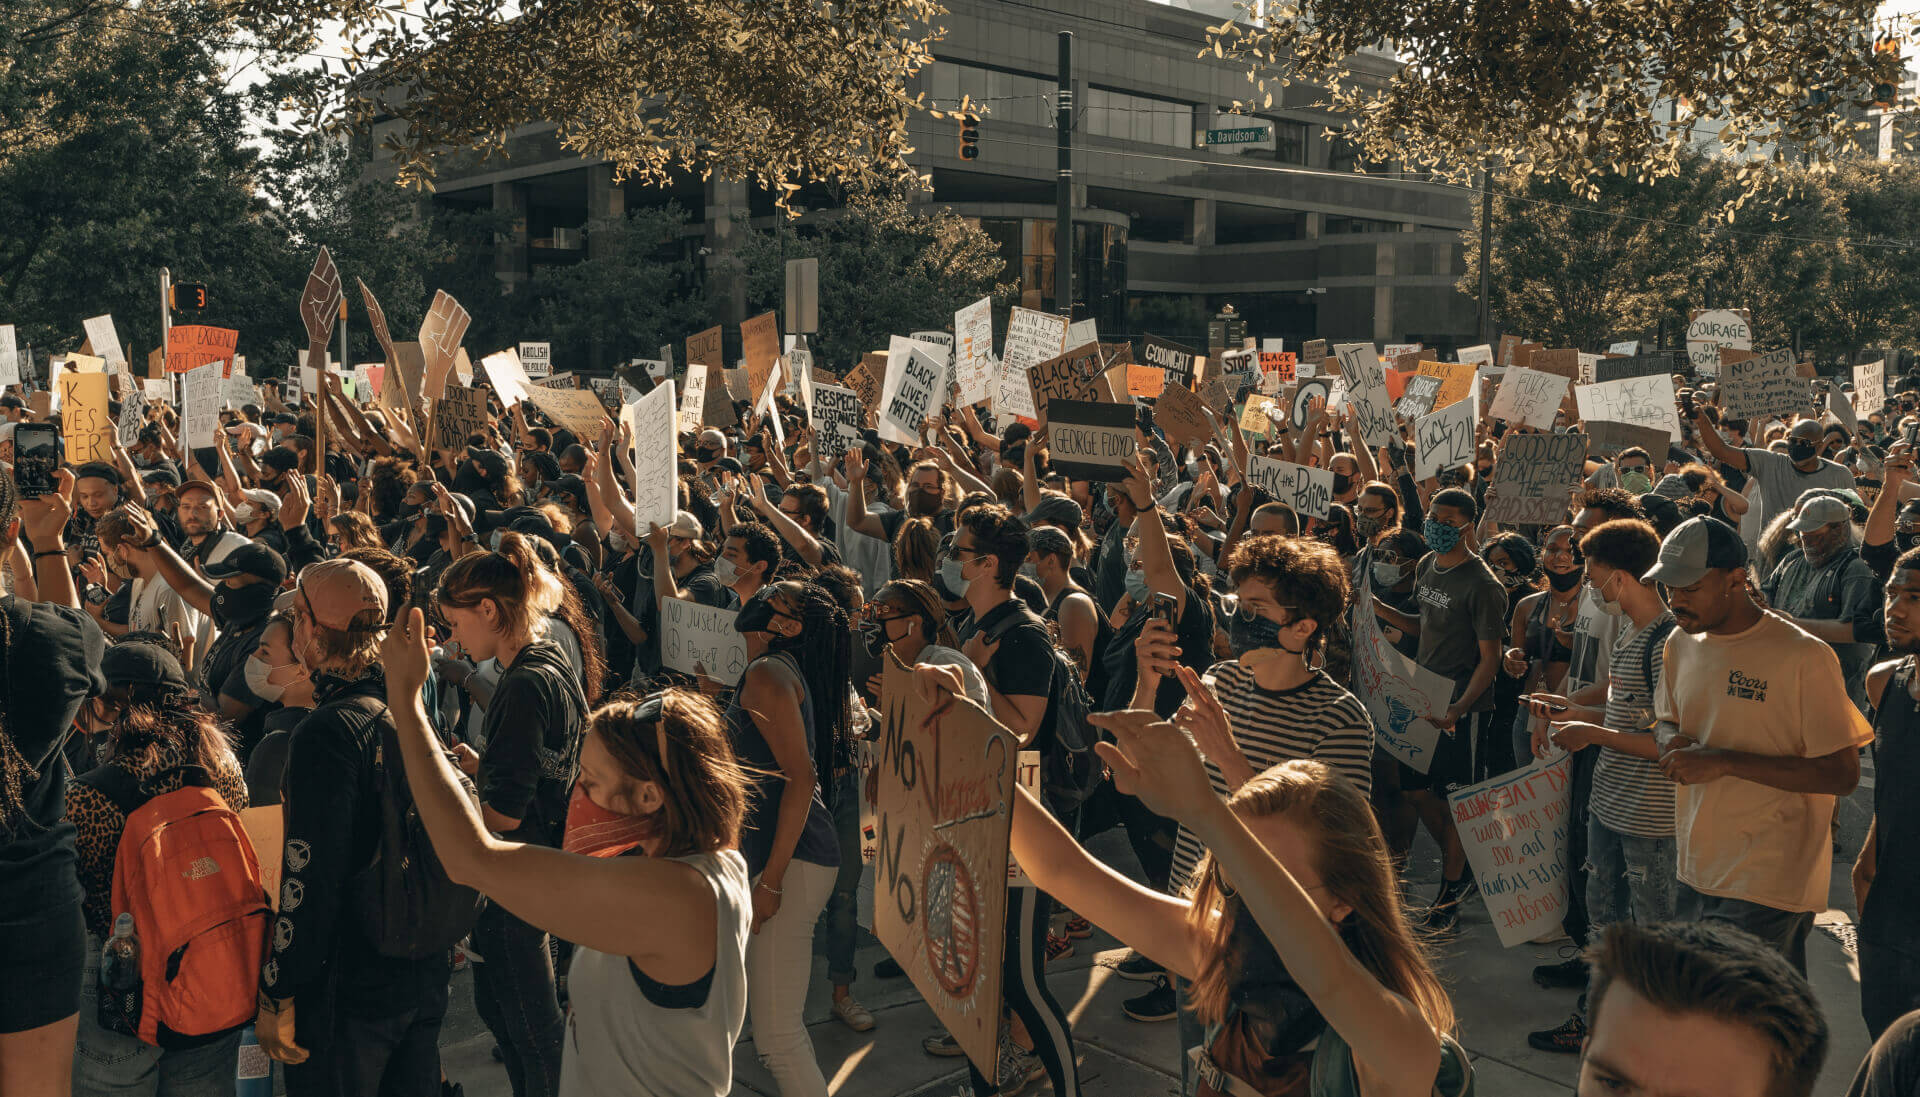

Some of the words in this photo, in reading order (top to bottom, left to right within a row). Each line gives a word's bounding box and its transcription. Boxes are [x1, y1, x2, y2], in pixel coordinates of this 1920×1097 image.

[1217, 130, 1256, 143] Davidson
[196, 287, 206, 308] 3
[1689, 321, 1747, 339] COURAGE
[522, 346, 548, 359] ABOLISH
[1259, 352, 1292, 362] BLACK
[1385, 347, 1398, 357] IF
[522, 362, 531, 371] THE
[531, 362, 548, 372] POLICE
[905, 356, 937, 393] BLACK
[1030, 356, 1079, 390] BLACK
[1223, 353, 1252, 375] STOP
[1260, 363, 1291, 372] LIVES
[1420, 363, 1454, 379] BLACK
[1731, 360, 1754, 377] NO
[1863, 364, 1877, 376] NO
[857, 365, 876, 385] BLACK
[846, 374, 873, 407] MATTER
[860, 379, 877, 398] LIVES
[900, 380, 929, 411] LIVES
[1515, 373, 1551, 403] FUCK
[1590, 379, 1665, 405] BLACK
[1864, 387, 1877, 400] NO
[815, 387, 857, 412] RESPECT
[1512, 395, 1535, 416] 45
[1593, 397, 1656, 419] LIVES
[888, 397, 925, 434] MATTER
[823, 420, 839, 434] OR
[816, 429, 855, 449] EXPECT
[1054, 428, 1098, 456] GEORGE
[1101, 431, 1136, 458] FLOYD
[1418, 413, 1452, 465] FUCK
[1505, 435, 1547, 462] GOOD
[1548, 434, 1586, 462] COPS
[1280, 471, 1295, 488] the
[1292, 467, 1329, 516] Police
[1518, 481, 1546, 497] THE
[1486, 496, 1521, 520] BAD
[667, 601, 682, 624] NO
[1728, 669, 1768, 690] Coors
